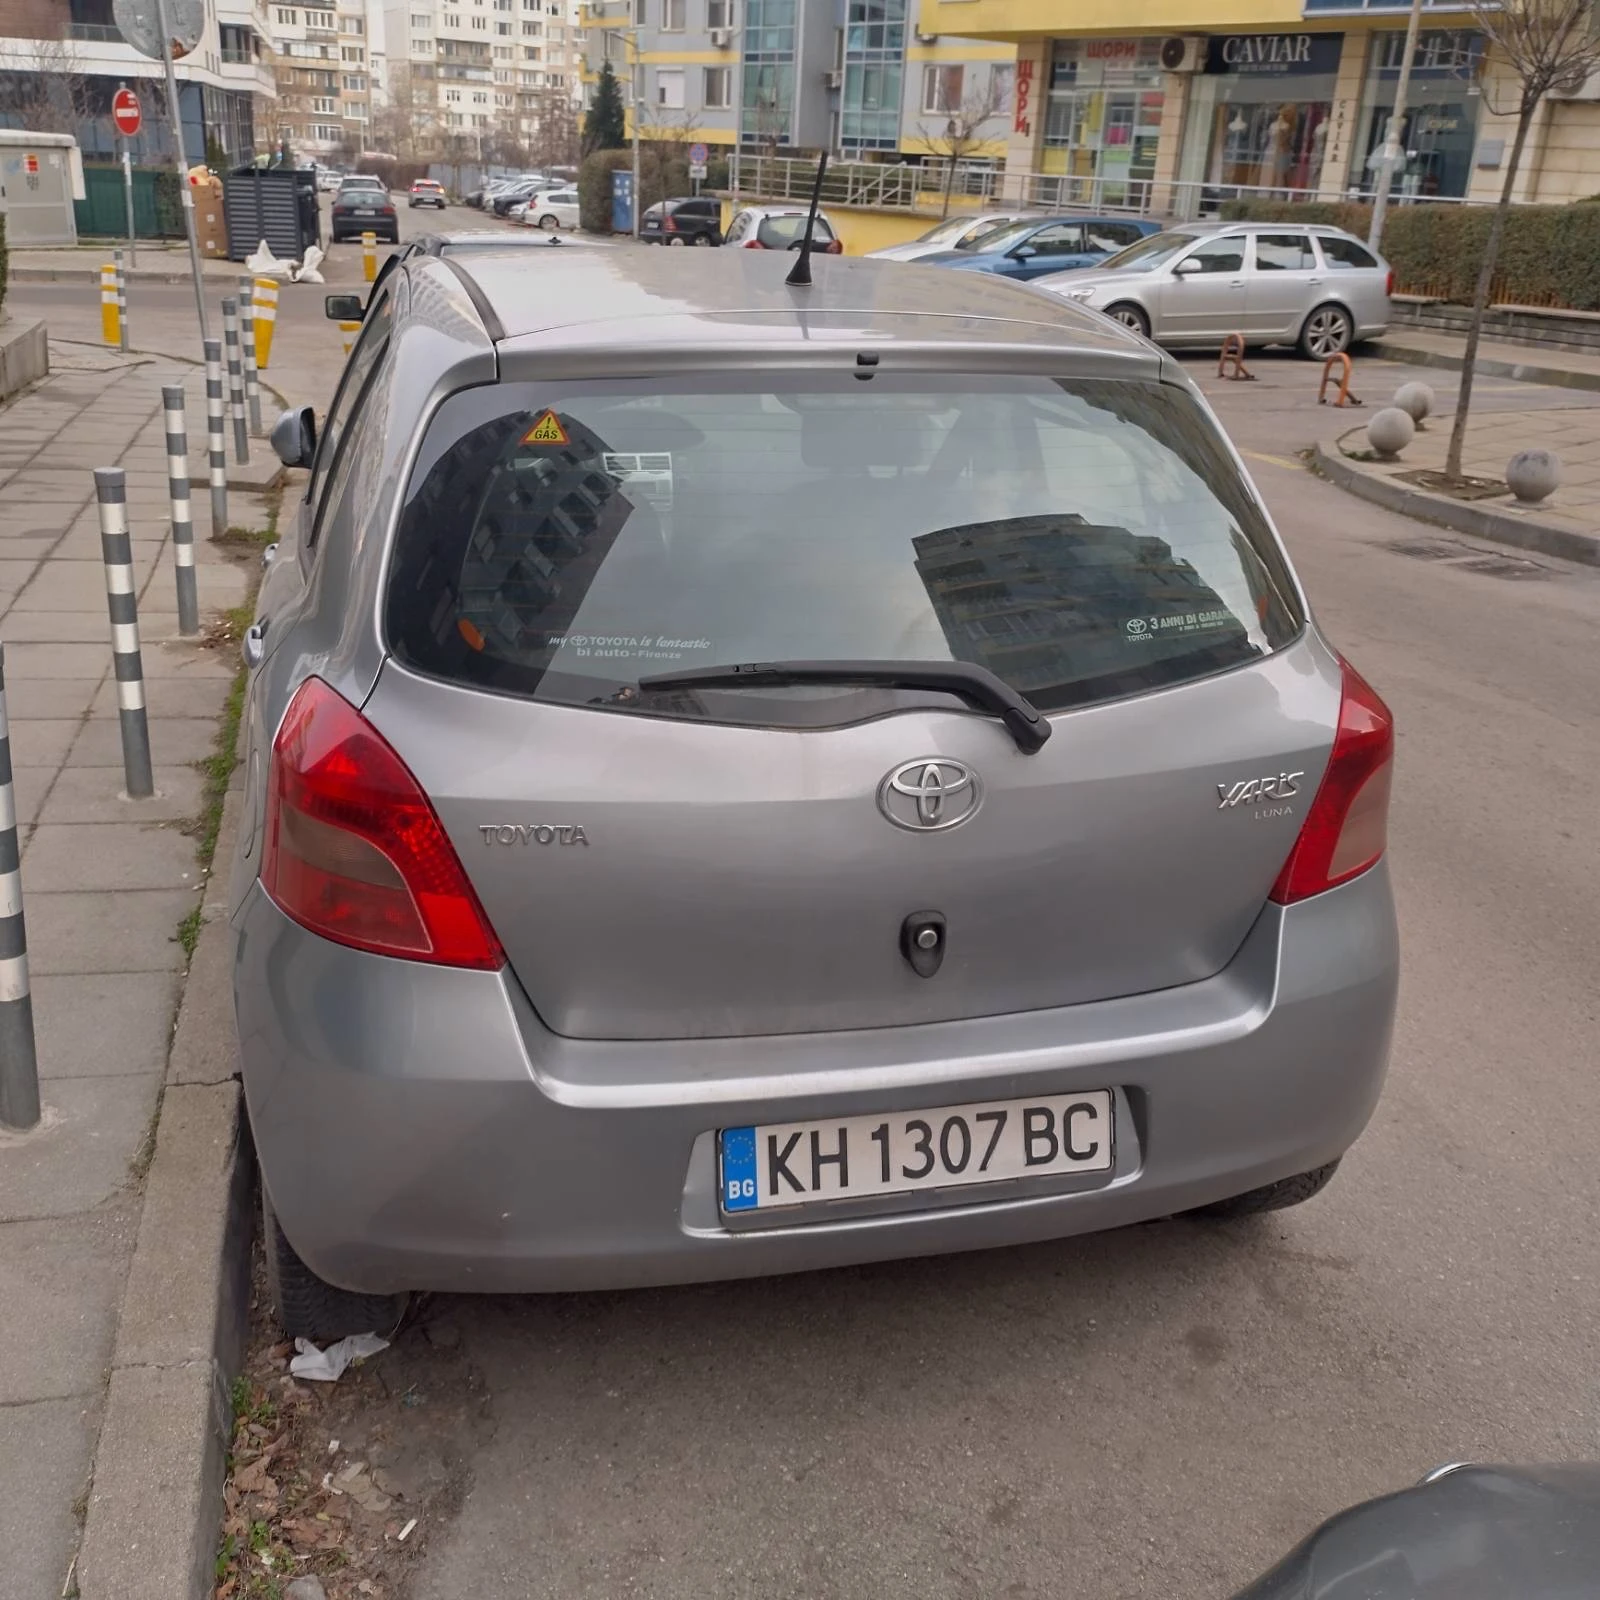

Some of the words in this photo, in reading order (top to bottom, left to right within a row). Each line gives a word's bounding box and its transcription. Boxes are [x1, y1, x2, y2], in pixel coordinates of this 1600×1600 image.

[1222, 35, 1311, 63] CAVIAR
[534, 429, 558, 440] GAS
[1149, 617, 1159, 630] 3
[1160, 615, 1185, 629] ANNI
[1185, 613, 1197, 625] DI
[549, 635, 568, 649] my
[590, 636, 638, 647] TOYOTA
[639, 635, 653, 647] is
[1126, 632, 1154, 642] TOYOTA
[1254, 805, 1294, 820] LUNA
[479, 823, 590, 846] TOYOTA
[768, 1126, 849, 1196] KH
[870, 1109, 1009, 1183] 1307
[1022, 1101, 1099, 1167] BC
[728, 1179, 755, 1200] BG
